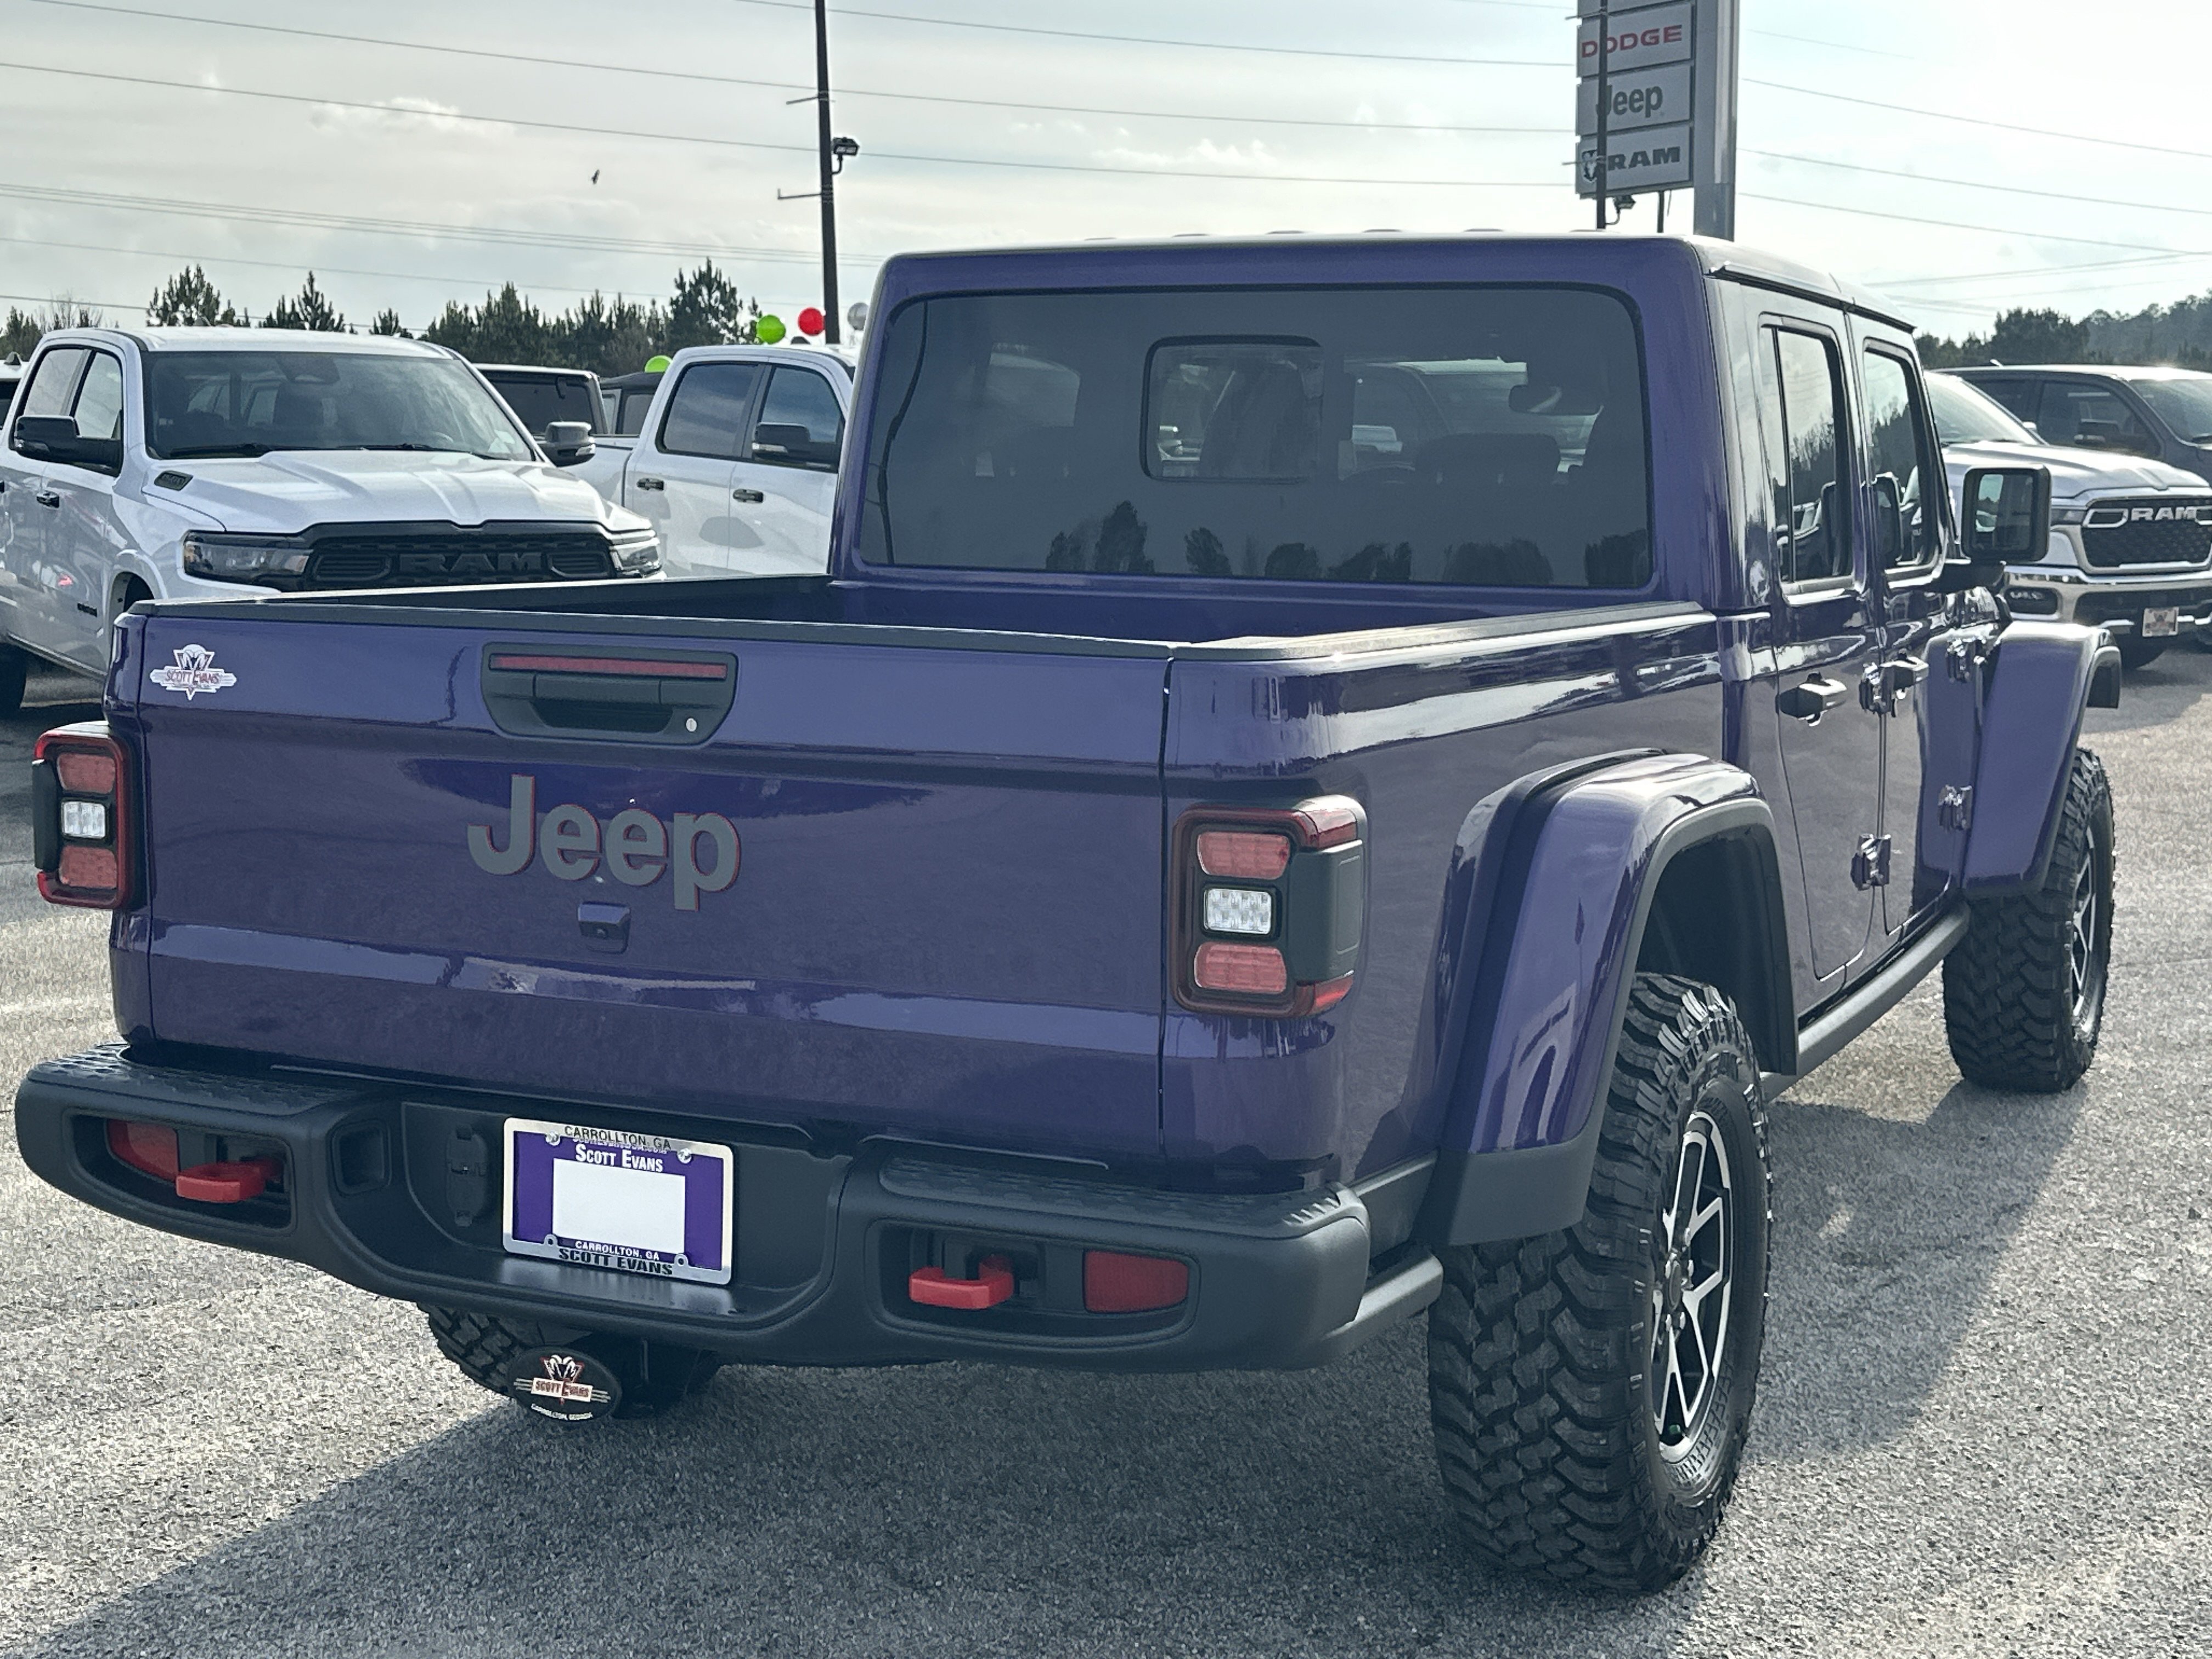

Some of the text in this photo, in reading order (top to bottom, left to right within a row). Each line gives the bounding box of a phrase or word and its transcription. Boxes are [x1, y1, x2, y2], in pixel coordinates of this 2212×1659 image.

[1582, 25, 1682, 58] DODGE
[1595, 84, 1663, 118] Jeep
[1607, 147, 1680, 171] RAM
[2131, 506, 2195, 521] RAM
[399, 552, 542, 572] RAM
[467, 774, 741, 912] Jeep
[653, 1137, 672, 1150] GA
[558, 1248, 673, 1276] SCOTT EVANS
